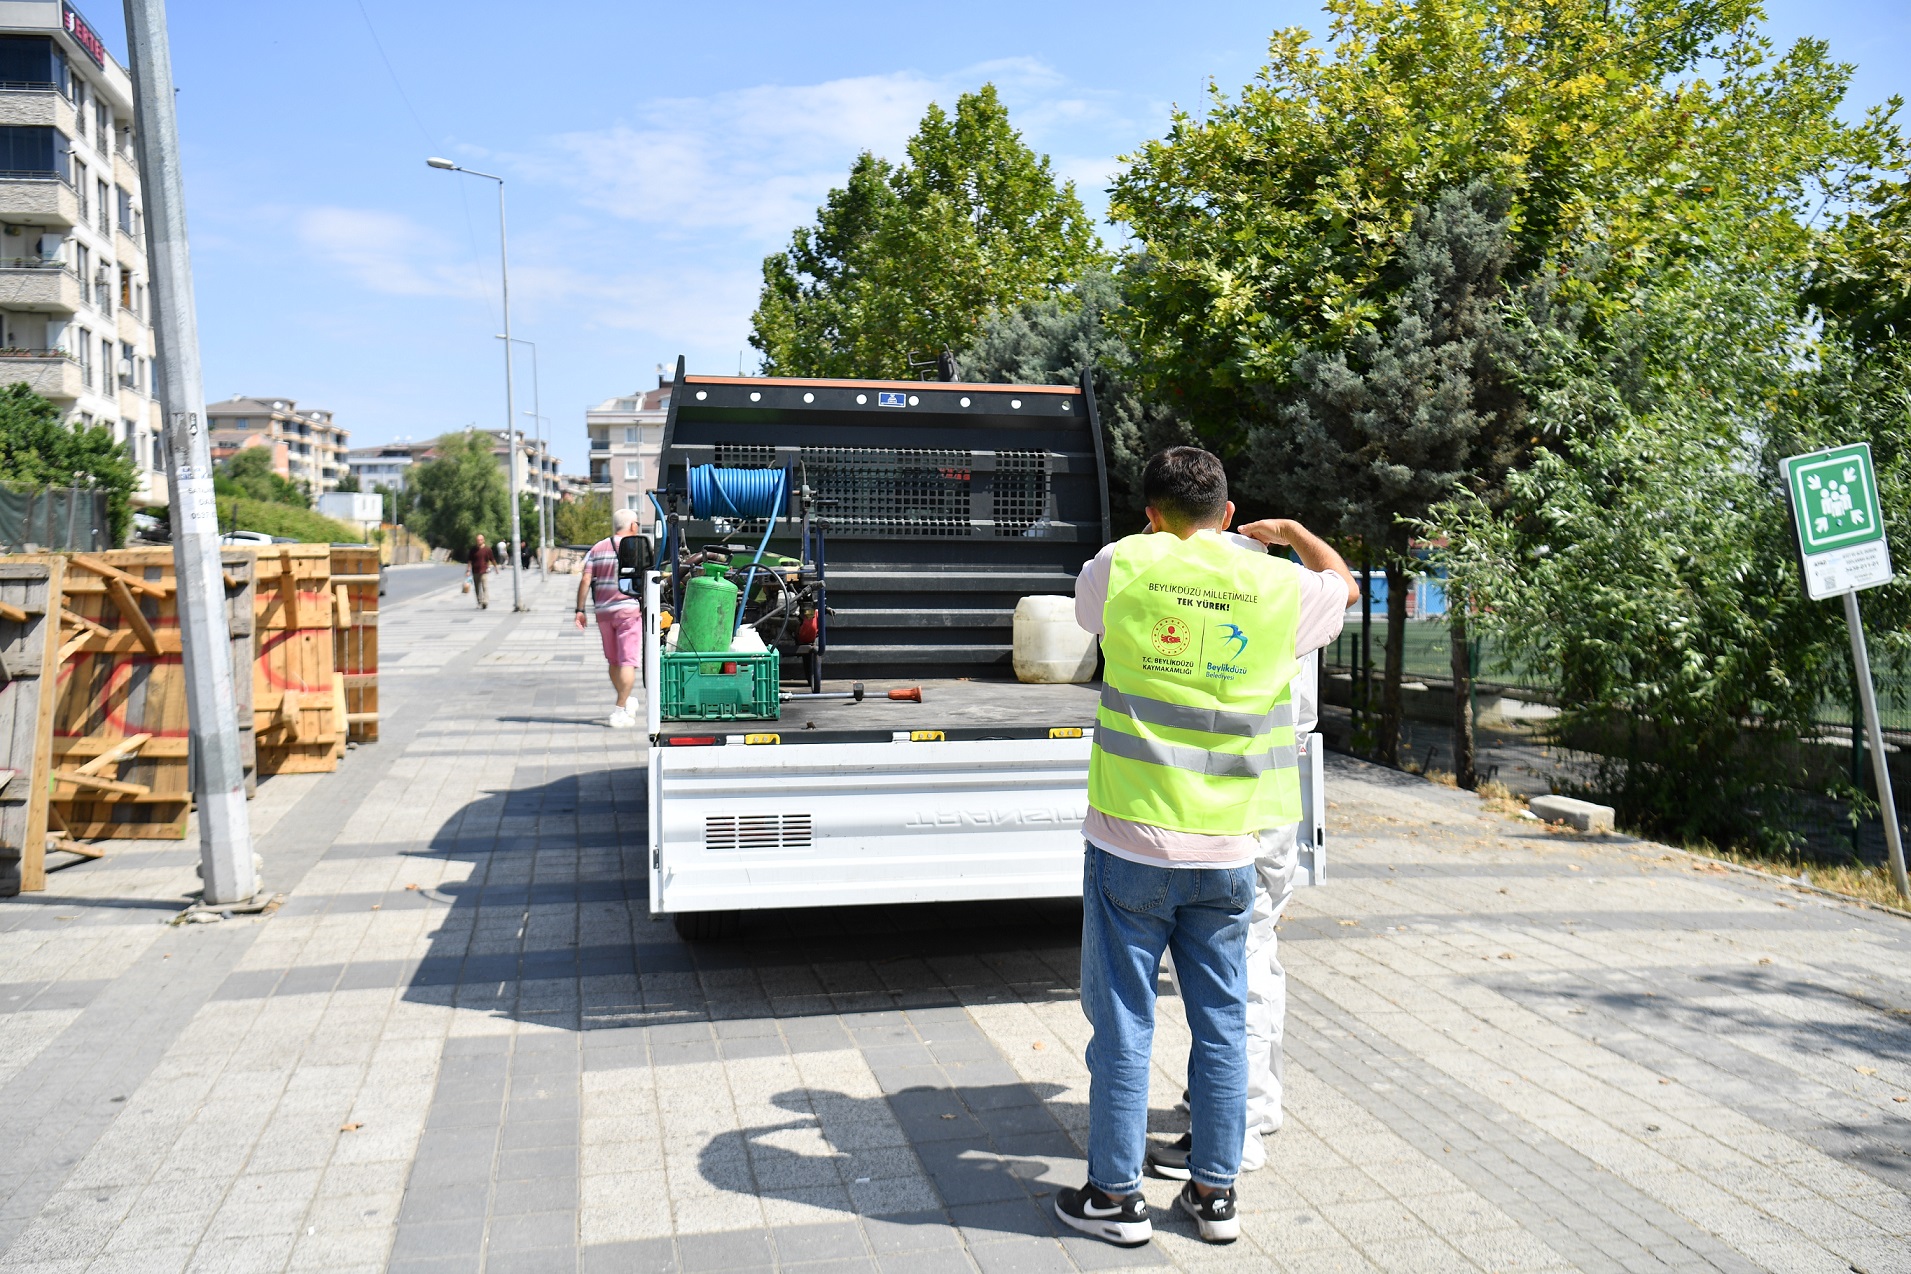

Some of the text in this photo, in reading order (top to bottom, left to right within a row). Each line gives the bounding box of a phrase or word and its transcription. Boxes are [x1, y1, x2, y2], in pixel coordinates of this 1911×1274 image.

[1148, 582, 1258, 604] BEYLİKDÜZÜ MİLLETİMİZLE
[1177, 597, 1230, 611] TEK YÜREK!
[1154, 657, 1194, 668] BEYLİKDÜZÜ
[1206, 662, 1248, 675] Beylikdüzü
[1142, 664, 1192, 675] KAYMAKAMLIĞI
[1205, 671, 1235, 681] Belediyesi
